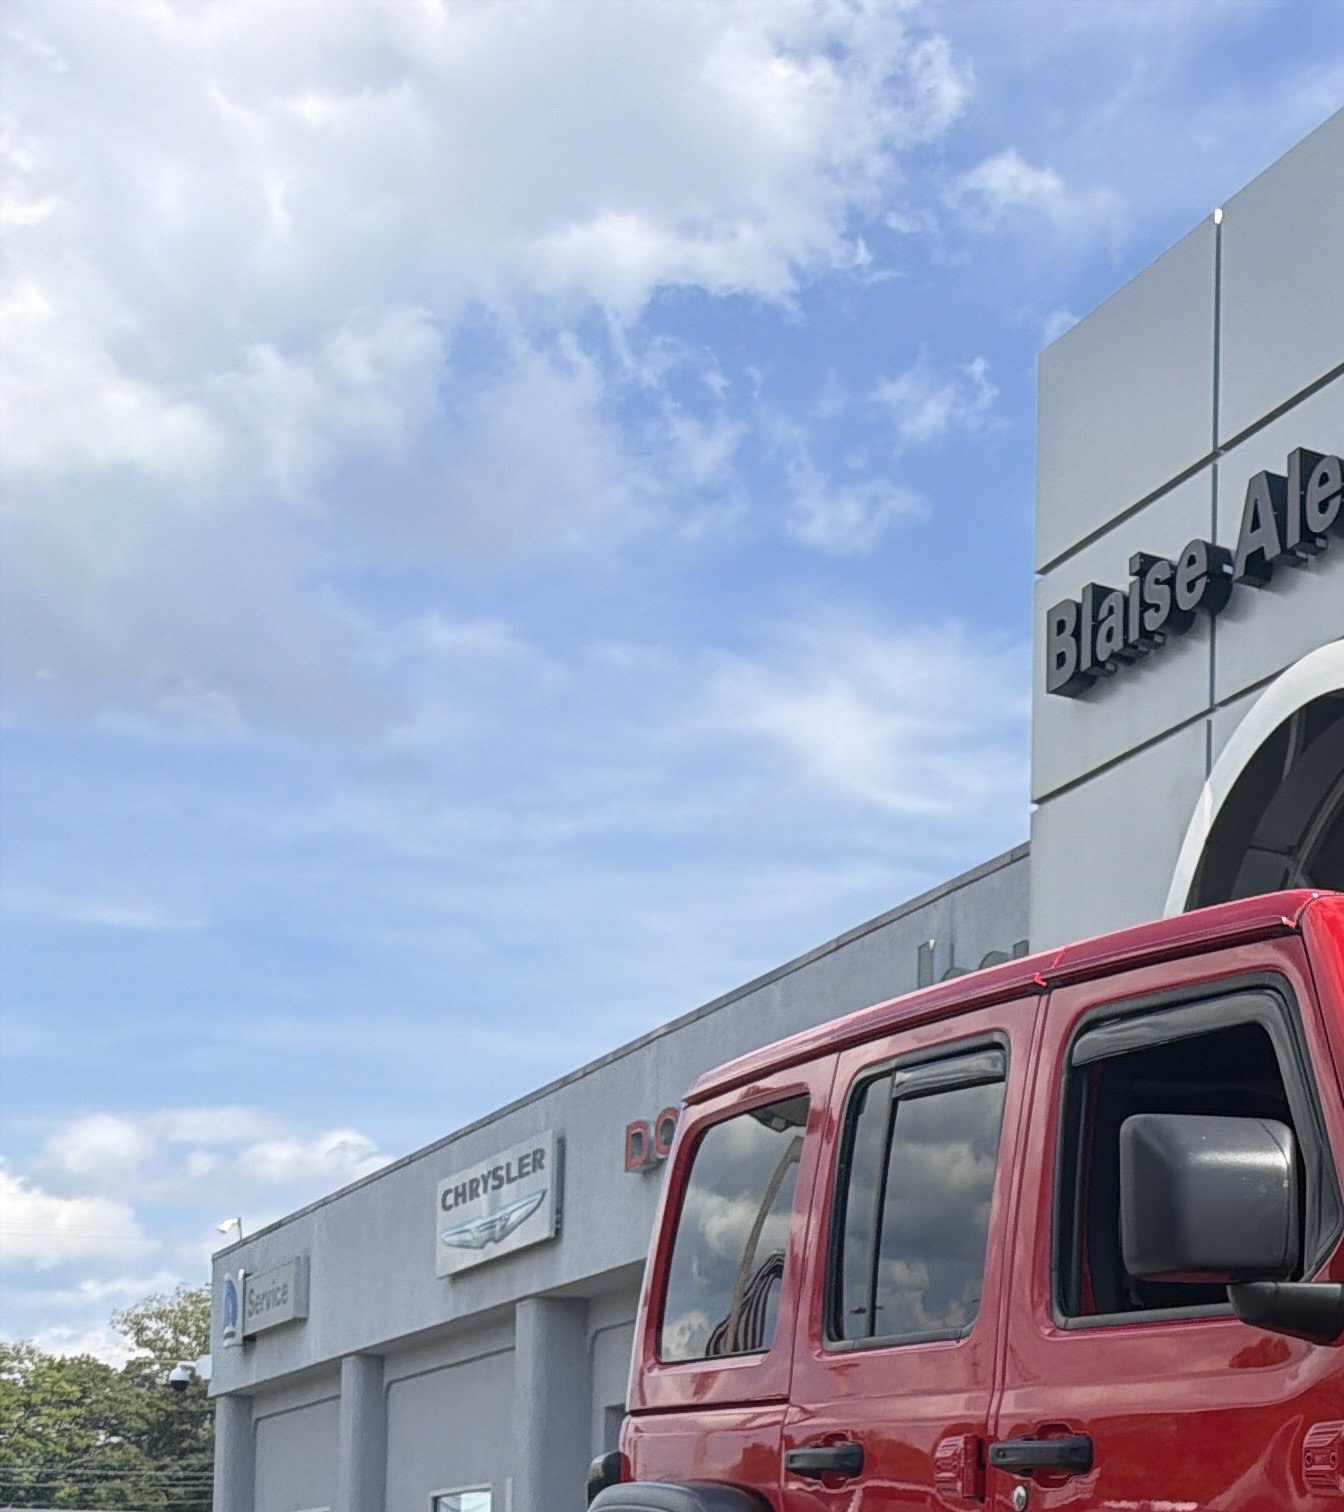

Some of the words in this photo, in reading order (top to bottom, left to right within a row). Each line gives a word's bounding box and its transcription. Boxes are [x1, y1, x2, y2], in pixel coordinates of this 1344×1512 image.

[1046, 538, 1232, 698] Blaise
[441, 1148, 546, 1211] CHRYSLER
[248, 1280, 288, 1317] Service
